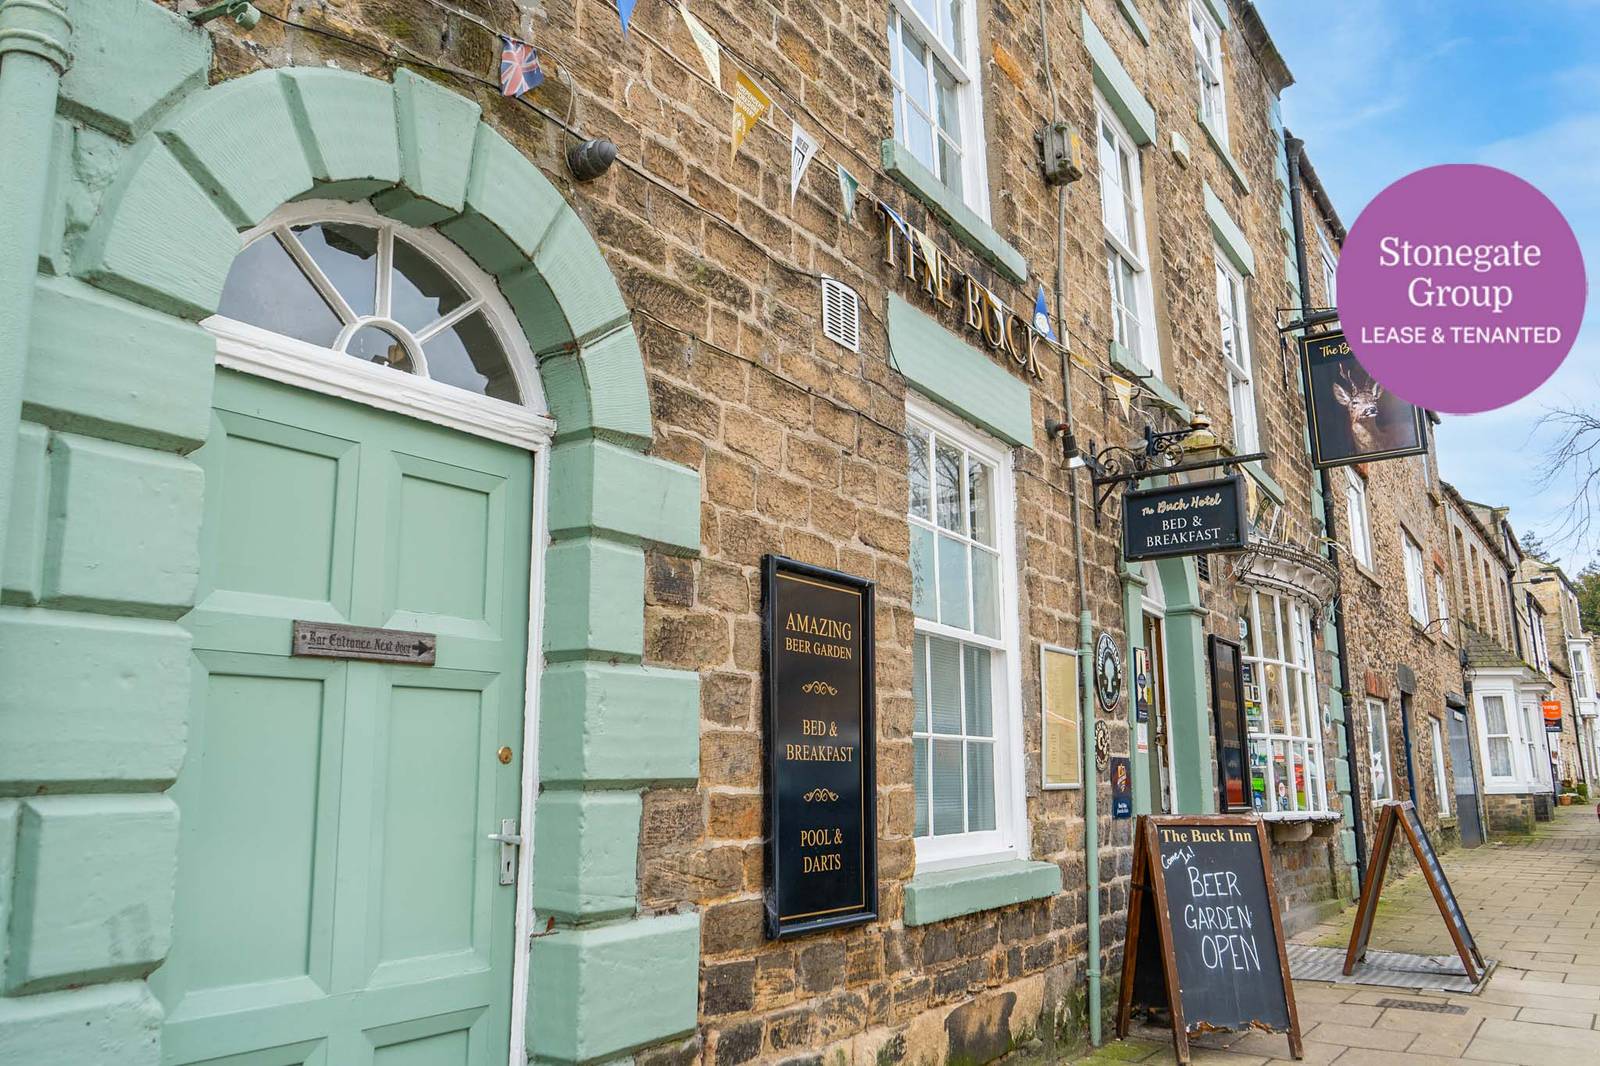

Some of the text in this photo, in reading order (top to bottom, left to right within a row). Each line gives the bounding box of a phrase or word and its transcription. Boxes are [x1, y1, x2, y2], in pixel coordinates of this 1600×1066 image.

[874, 200, 1044, 381] THE BUCK
[1319, 345, 1338, 358] The
[1141, 493, 1222, 517] The Buck Hotel
[1162, 515, 1203, 531] BED &
[1146, 527, 1221, 547] BREAKFAST
[785, 611, 852, 641] AMAZING
[308, 630, 327, 646] Bar
[329, 633, 371, 650] Entrance
[374, 638, 393, 652] Next
[785, 637, 852, 660] BEER GARDEN
[803, 719, 838, 737] BED &
[786, 744, 853, 762] BREAKFAST
[801, 828, 843, 847] POOL &
[1160, 829, 1252, 843] The Buck Inn
[804, 853, 841, 874] DARTS
[1187, 866, 1241, 898] BEER
[1184, 904, 1252, 930] GARDEN
[1201, 935, 1261, 971] OPEN
